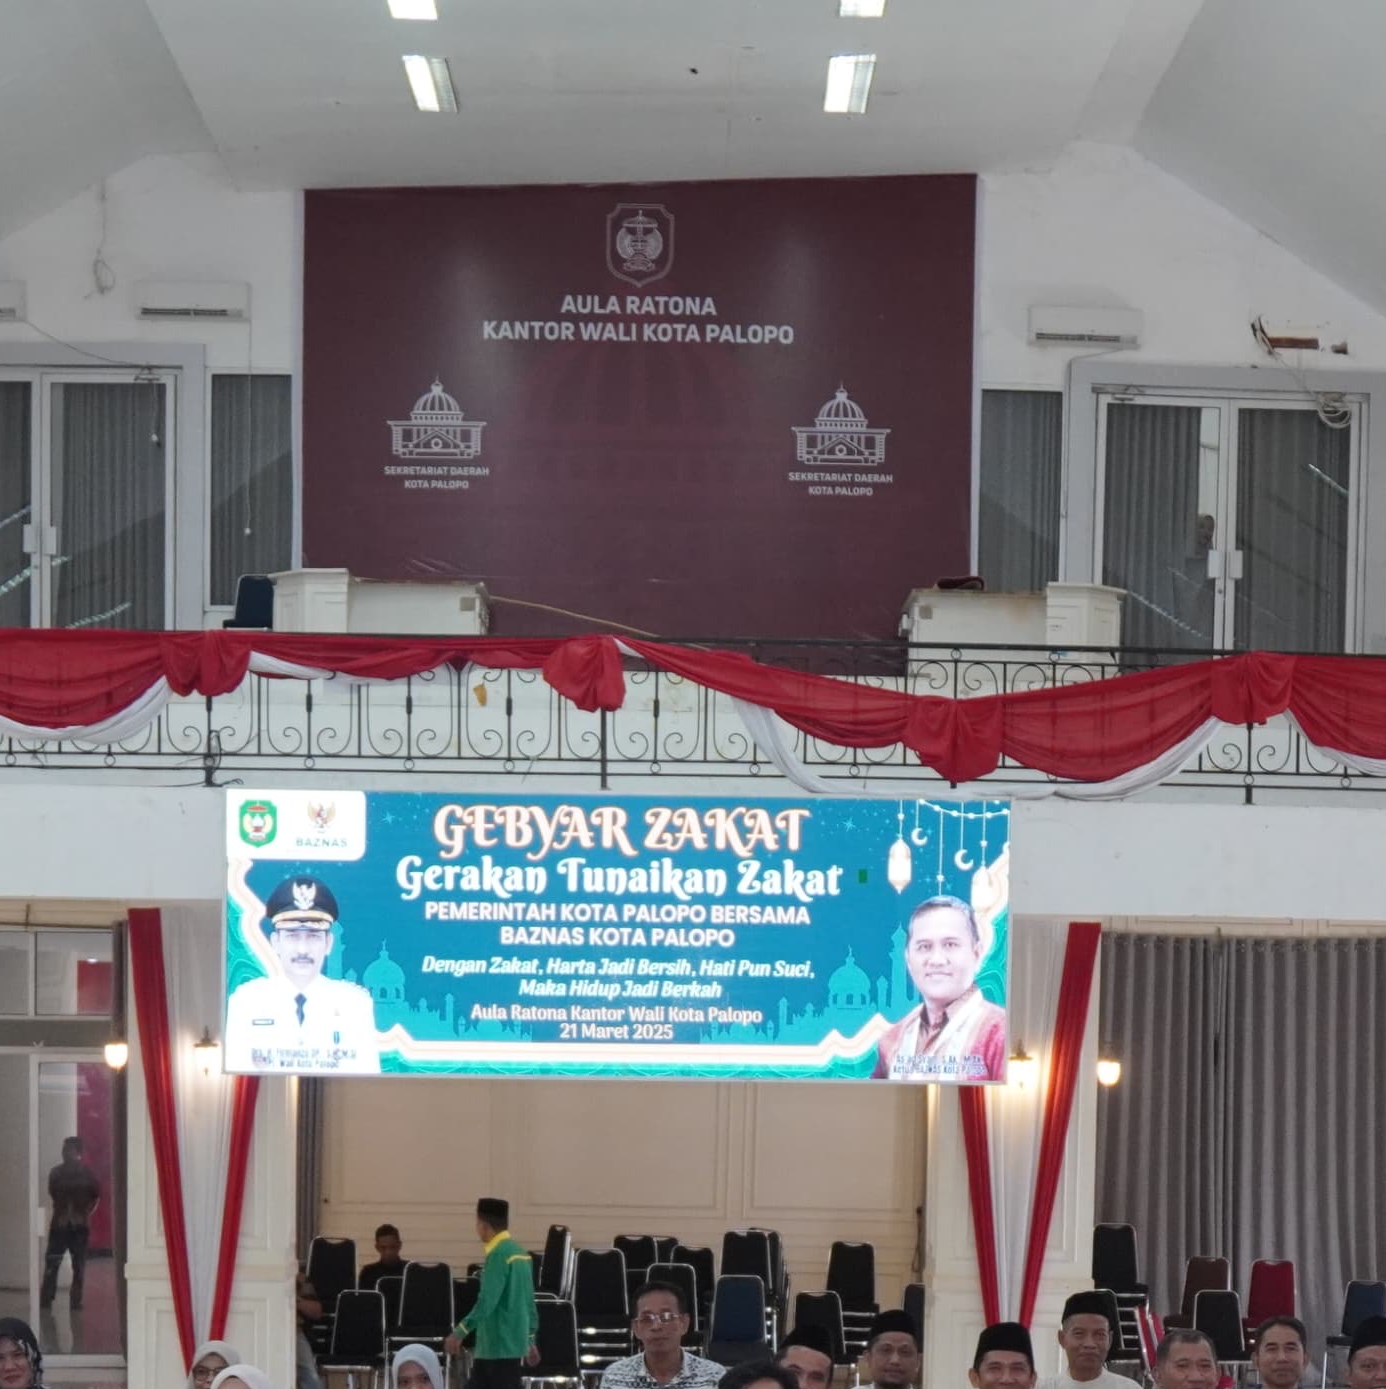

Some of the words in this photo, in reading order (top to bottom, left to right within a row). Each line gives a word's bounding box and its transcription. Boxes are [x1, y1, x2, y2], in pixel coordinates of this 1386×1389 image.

[560, 295, 621, 314] AULA
[625, 296, 717, 316] RATONA
[482, 320, 574, 341] KANTOR
[579, 322, 637, 341] WALI
[642, 323, 701, 343] KOTA
[705, 324, 794, 345] PALOPO
[384, 465, 448, 475] SEKRETARIAT
[450, 466, 490, 476] DAERAH
[788, 472, 853, 482] SEKRETARIAT
[854, 473, 893, 483] DAERAH
[404, 480, 429, 489] KOTA
[431, 480, 469, 489] PALOPO
[808, 486, 833, 495] KOTA
[835, 486, 874, 496] PALOPO
[296, 837, 348, 847] BAZNAS
[433, 804, 639, 860] GEBYAR
[644, 806, 813, 857] ZAKAT
[396, 855, 547, 900] Gerakan
[556, 857, 727, 900] Tunaikan
[736, 859, 844, 902] Zakat
[425, 902, 556, 921] PEMERINTAH
[561, 903, 618, 922] KOTA
[623, 904, 707, 923] PALOPO
[710, 905, 811, 924] BERSAMA
[500, 926, 584, 945] BAZNAS
[589, 927, 646, 946] KOTA
[651, 928, 735, 947] PALOPO
[421, 955, 486, 977] Dengan
[488, 956, 544, 975] Zakat,
[546, 957, 596, 975] Harta
[598, 958, 635, 976] Jadi
[637, 958, 696, 977] Bersih,
[699, 959, 736, 977] Hati
[738, 960, 771, 977] Pun
[772, 960, 815, 979] Suci,
[518, 979, 567, 996] Maka
[569, 979, 621, 1000] Hidup
[622, 980, 660, 997] Jadi
[661, 981, 723, 998] Berkah
[470, 1004, 508, 1020] Aula
[510, 1004, 568, 1020] Ratona
[571, 1005, 625, 1021] Kantor
[628, 1005, 665, 1021] Wali
[668, 1006, 704, 1022] Kota
[708, 1006, 763, 1026] Palopo
[560, 1023, 577, 1038] 21
[581, 1023, 629, 1039] Maret
[633, 1024, 673, 1039] 2025
